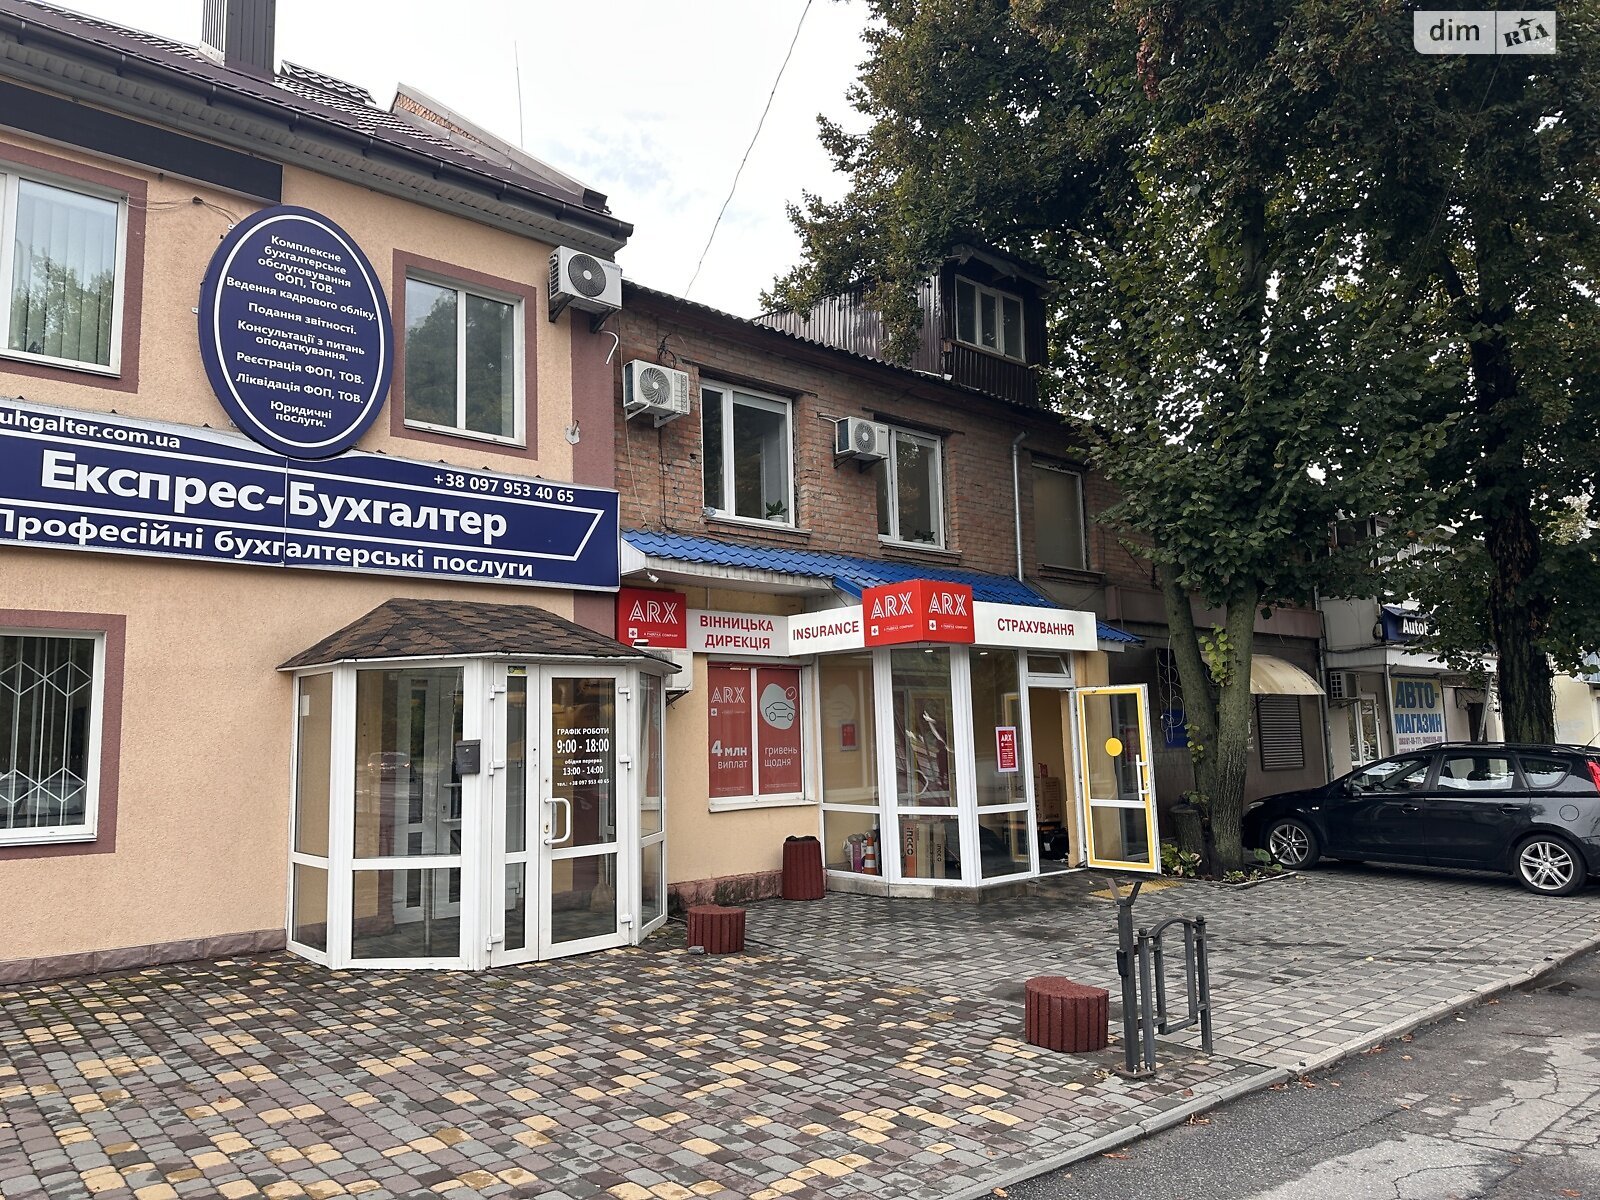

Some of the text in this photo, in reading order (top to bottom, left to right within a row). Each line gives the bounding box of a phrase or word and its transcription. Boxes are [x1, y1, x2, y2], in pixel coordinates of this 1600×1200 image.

[264, 246, 347, 275] бухгалтерське
[271, 235, 342, 262] Комплексне
[258, 258, 351, 288] обслуговування
[274, 272, 336, 294] ФОП, ТОВ.
[226, 277, 377, 322] Ведення кадрового обліку.
[249, 303, 357, 335] Подання звітності.
[238, 320, 365, 355] Консультації з питань
[256, 336, 348, 362] оподаткування.
[237, 352, 365, 384] Реєстрація ФОП, ТОВ.
[236, 373, 364, 404] Ліквідація ФОП, ТОВ.
[270, 401, 332, 419] Юридичні
[276, 412, 326, 428] послуги.
[41, 449, 508, 545] Експрес-Бухгалтер
[434, 473, 574, 503] +38 097 953 40 65
[214, 530, 424, 568] бухгалтерські
[433, 554, 534, 578] послуги
[628, 600, 678, 624] ARX
[870, 592, 913, 620] ARX
[928, 592, 967, 616] ARX
[700, 615, 774, 632] ВІННИЦЬКА
[792, 620, 859, 640] INSURANCE
[997, 618, 1074, 636] СТРАХУВАННЯ
[705, 634, 771, 650] ДИРЕКЦІЯ
[711, 686, 745, 703] ARX
[1395, 682, 1439, 708] АВТО-
[1395, 713, 1442, 733] МАГАЗИН
[557, 739, 576, 754] 9:00
[586, 739, 609, 752] 18:00
[712, 740, 797, 757] 4 млн гривень
[563, 767, 580, 776] 13:00
[587, 766, 604, 774] 14:00
[718, 760, 748, 770] виплат
